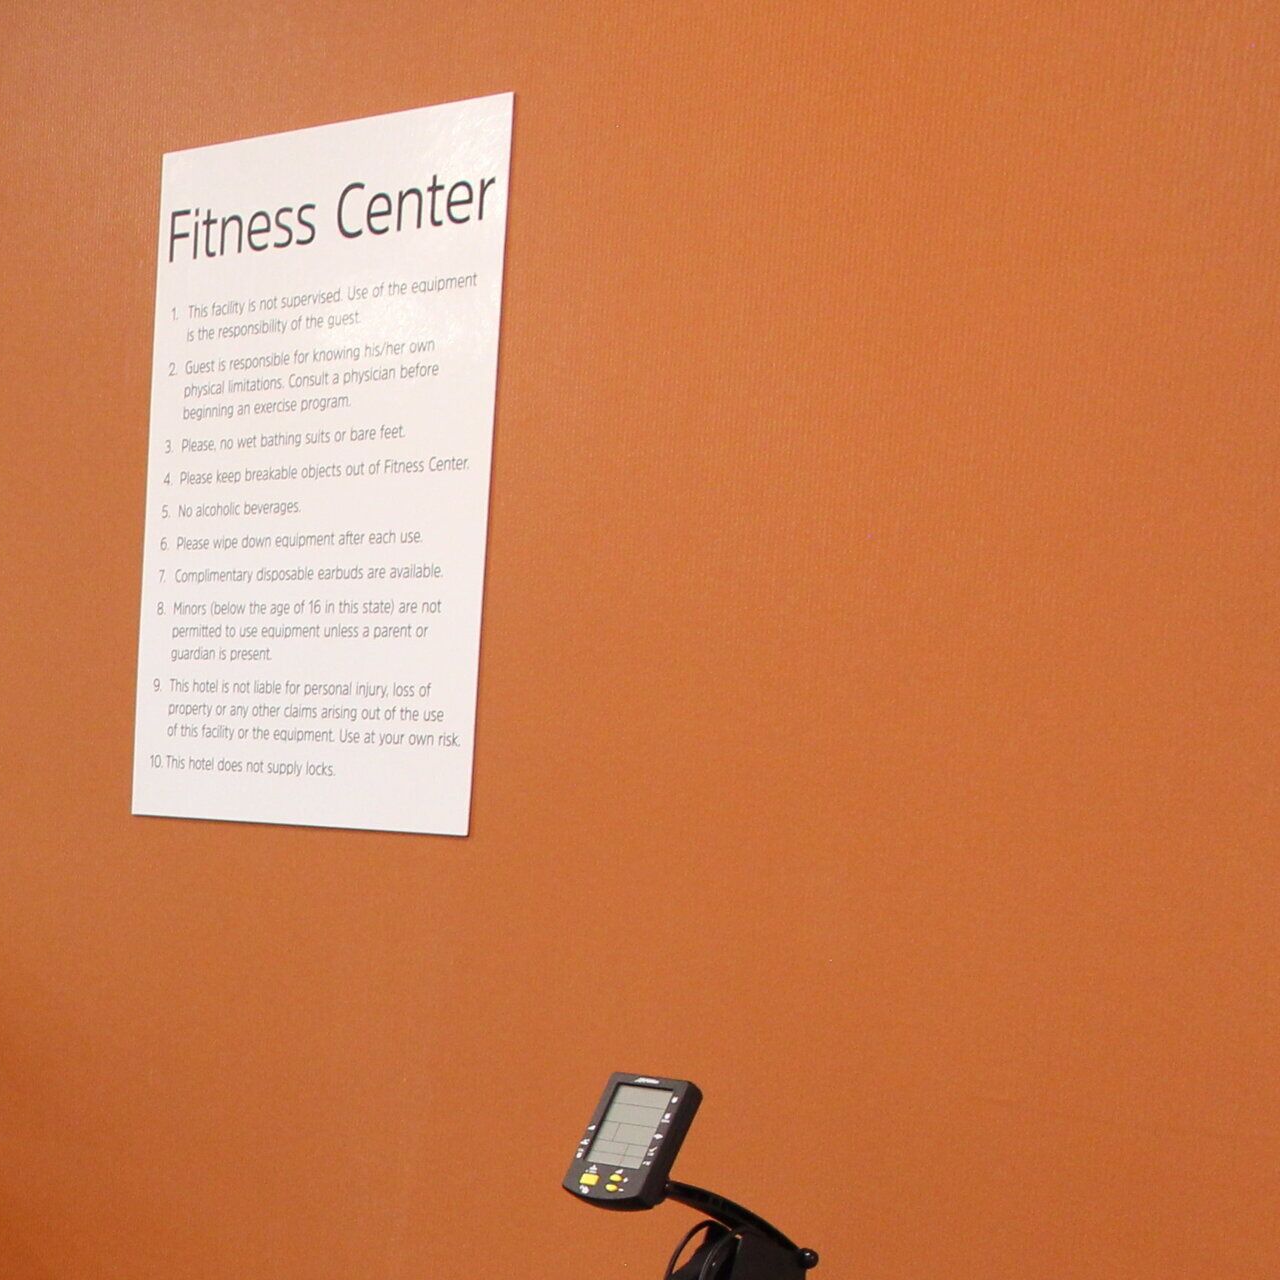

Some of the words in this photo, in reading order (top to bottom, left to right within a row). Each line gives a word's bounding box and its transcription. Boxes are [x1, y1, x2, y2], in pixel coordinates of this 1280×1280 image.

[168, 203, 316, 263] Fitness
[336, 174, 496, 239] Center
[188, 303, 209, 319] This
[211, 300, 246, 317] facility
[247, 298, 257, 313] is
[259, 295, 278, 311] not
[347, 285, 369, 302] Use
[371, 281, 385, 299] of
[387, 280, 408, 297] the
[410, 272, 478, 295] equipment
[186, 327, 195, 343] is
[197, 325, 216, 342] the
[217, 318, 288, 340] responsibility
[290, 314, 303, 332] of
[305, 313, 325, 330] the
[168, 361, 178, 377] 2.
[184, 359, 216, 376] Guest
[217, 357, 227, 372] is
[229, 351, 291, 372] responsible
[293, 349, 310, 365] for
[312, 347, 361, 363] knowing
[364, 341, 406, 358] his/her
[408, 339, 436, 354] own
[183, 380, 226, 400] physical
[227, 375, 285, 394] limitations.
[287, 370, 330, 389] Consult
[331, 372, 340, 386] a
[342, 366, 396, 386] physician
[399, 361, 440, 380] before
[182, 403, 235, 422] beginning
[236, 403, 251, 417] an
[253, 397, 298, 415] exercise
[299, 395, 352, 413] program.
[164, 439, 174, 455] 3.
[181, 437, 217, 453] Please,
[219, 438, 234, 451] no
[236, 434, 258, 449] wet
[259, 431, 302, 448] bathing
[305, 429, 331, 445] suits
[333, 430, 347, 443] or
[349, 426, 377, 442] bare
[379, 423, 406, 440] feet.
[162, 471, 173, 486] 4.
[179, 470, 214, 486] Please
[215, 469, 242, 485] keep
[244, 465, 298, 482] breakable
[300, 463, 343, 481] objects
[344, 461, 365, 477] out
[368, 458, 382, 476] of
[383, 458, 425, 474] Fitness
[428, 455, 469, 472] Center.
[161, 504, 171, 519] 5.
[177, 503, 194, 519] No
[195, 501, 241, 518] alcoholic
[243, 500, 300, 517] beverages.
[159, 536, 170, 552] 6.
[176, 535, 210, 551] Please
[212, 535, 239, 552] wipe
[240, 534, 272, 549] down
[274, 532, 335, 550] equipment
[337, 530, 366, 546] after
[368, 529, 397, 545] each
[399, 530, 423, 544] use.
[158, 569, 168, 583] 7.
[174, 568, 254, 585] Complimentary
[255, 565, 315, 583] disposable
[317, 564, 364, 581] earbuds
[366, 567, 387, 580] are
[389, 562, 442, 579] available.
[156, 601, 167, 616] 8.
[172, 601, 207, 616] Minors
[210, 600, 246, 617] (below
[248, 600, 267, 615] the
[269, 602, 291, 617] age
[293, 599, 306, 615] of
[308, 599, 322, 615] 16
[324, 599, 335, 614] in
[338, 599, 359, 615] this
[362, 598, 395, 617] state)
[397, 601, 418, 614] are
[421, 599, 442, 614] not
[171, 623, 223, 639] permitted
[224, 623, 237, 638] to
[239, 626, 259, 639] use
[260, 623, 321, 640] equipment
[323, 622, 359, 639] unless
[361, 625, 370, 639] a
[373, 623, 413, 640] parent
[415, 625, 429, 639] or
[170, 645, 216, 663] guardian
[218, 646, 227, 661] is
[229, 647, 273, 662] present.
[152, 677, 163, 693] 9.
[169, 677, 190, 693] This
[192, 679, 219, 694] hotel
[221, 681, 230, 694] is
[232, 679, 251, 695] not
[253, 679, 283, 695] liable
[285, 679, 302, 695] for
[303, 681, 353, 697] personal
[355, 681, 389, 700] injury,
[392, 682, 416, 698] loss
[418, 682, 432, 698] of
[167, 702, 214, 718] property
[215, 704, 228, 717] or
[229, 704, 250, 719] any
[251, 702, 282, 718] other
[283, 703, 318, 719] claims
[320, 705, 358, 723] arising
[360, 706, 382, 721] out
[383, 705, 398, 721] of
[399, 706, 420, 722] the
[422, 709, 445, 723] use
[166, 722, 179, 737] of
[180, 723, 199, 738] this
[201, 723, 235, 741] facility
[237, 727, 250, 740] or
[251, 725, 270, 741] the
[272, 727, 336, 744] equipment.
[338, 728, 361, 744] Use
[363, 729, 376, 745] at
[378, 732, 406, 747] your
[407, 733, 435, 746] own
[437, 731, 461, 748] risk.
[149, 753, 164, 769] 10.
[165, 754, 186, 770] This
[188, 755, 215, 772] hotel
[216, 757, 243, 773] does
[245, 760, 265, 774] not
[266, 760, 303, 778] supply
[305, 759, 335, 777] locks.
